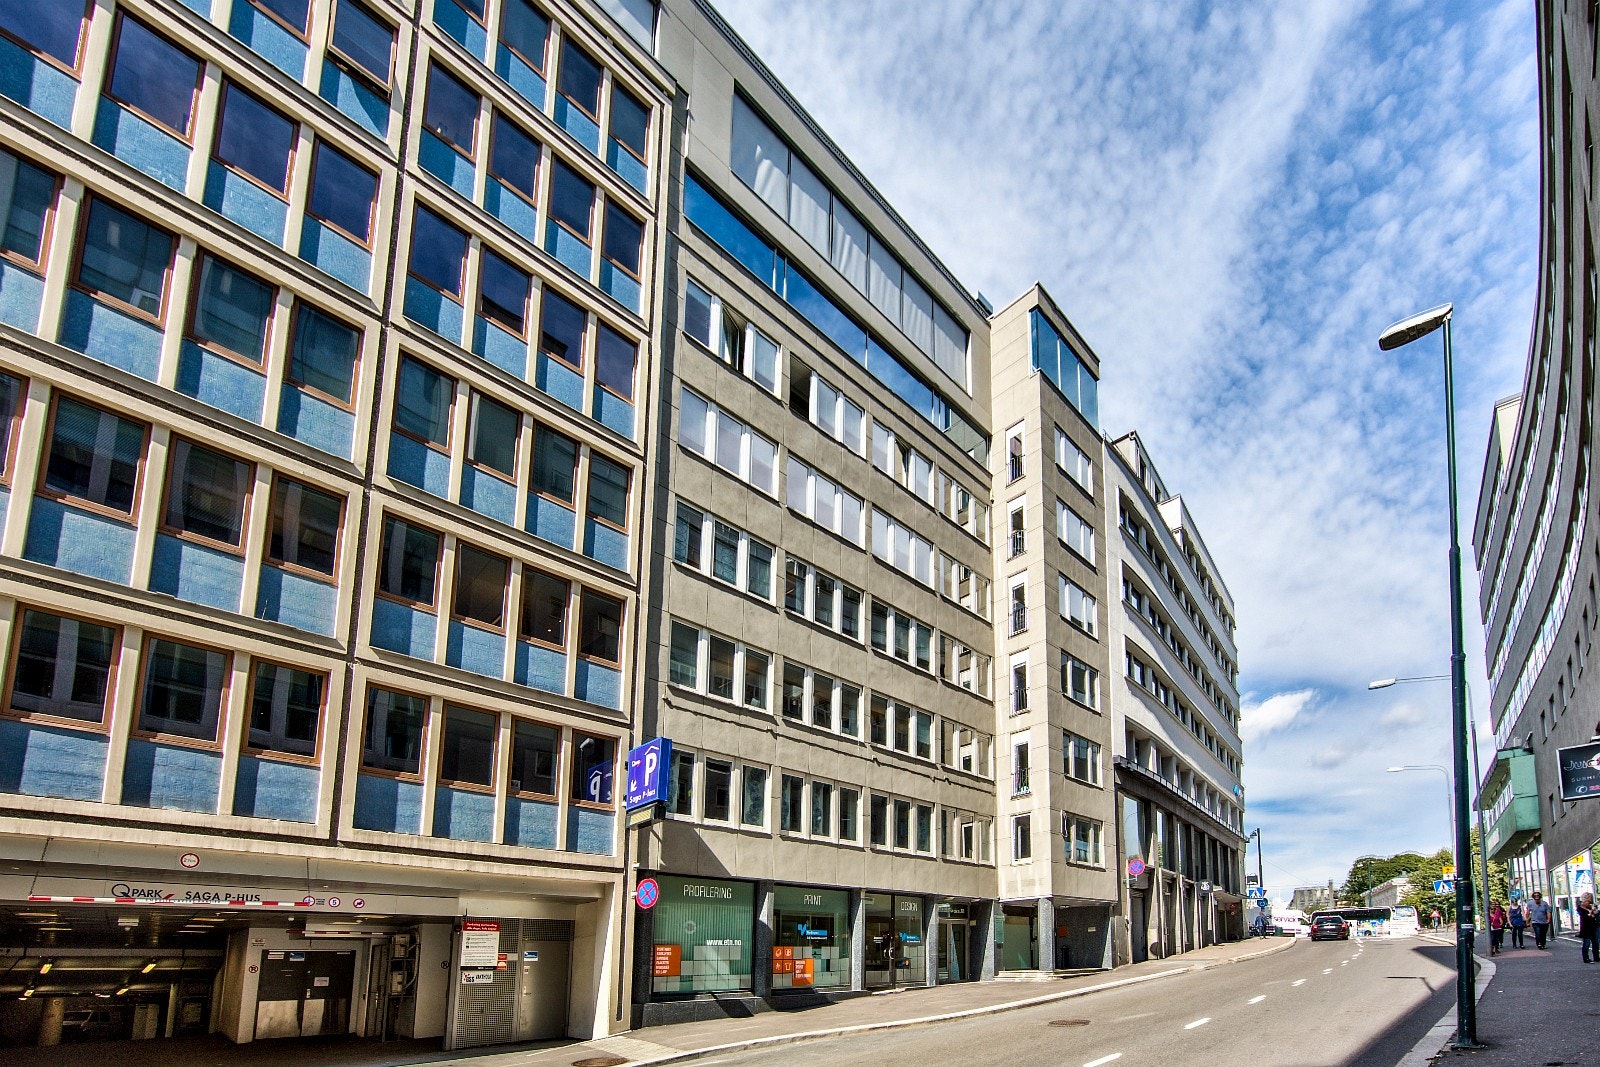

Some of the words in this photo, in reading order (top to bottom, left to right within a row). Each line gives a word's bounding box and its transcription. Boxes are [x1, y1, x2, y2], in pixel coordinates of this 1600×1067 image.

[645, 753, 657, 786] P
[630, 795, 641, 803] Saga
[185, 890, 220, 901] SAGA
[225, 893, 261, 902] P-HUS
[683, 884, 732, 899] PROFILERING
[803, 894, 822, 906] PRINT
[900, 901, 918, 911] DESIGN
